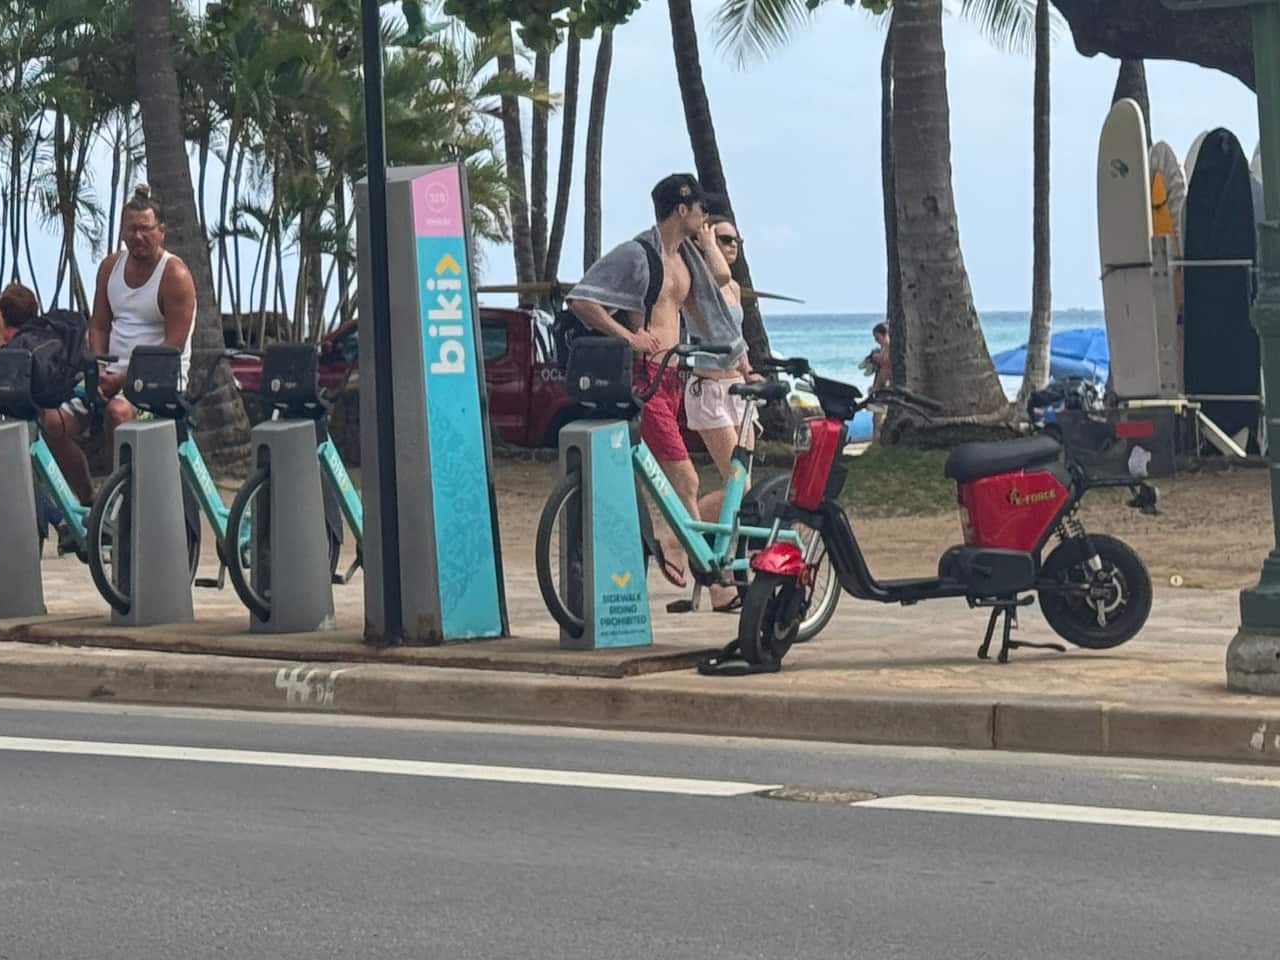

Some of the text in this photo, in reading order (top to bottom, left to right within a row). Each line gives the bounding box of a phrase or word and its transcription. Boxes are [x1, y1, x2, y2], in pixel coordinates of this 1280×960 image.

[426, 277, 466, 374] biki
[602, 593, 641, 604] SIDEWALK
[609, 604, 637, 615] RIDING
[600, 615, 647, 627] PROHIBITED
